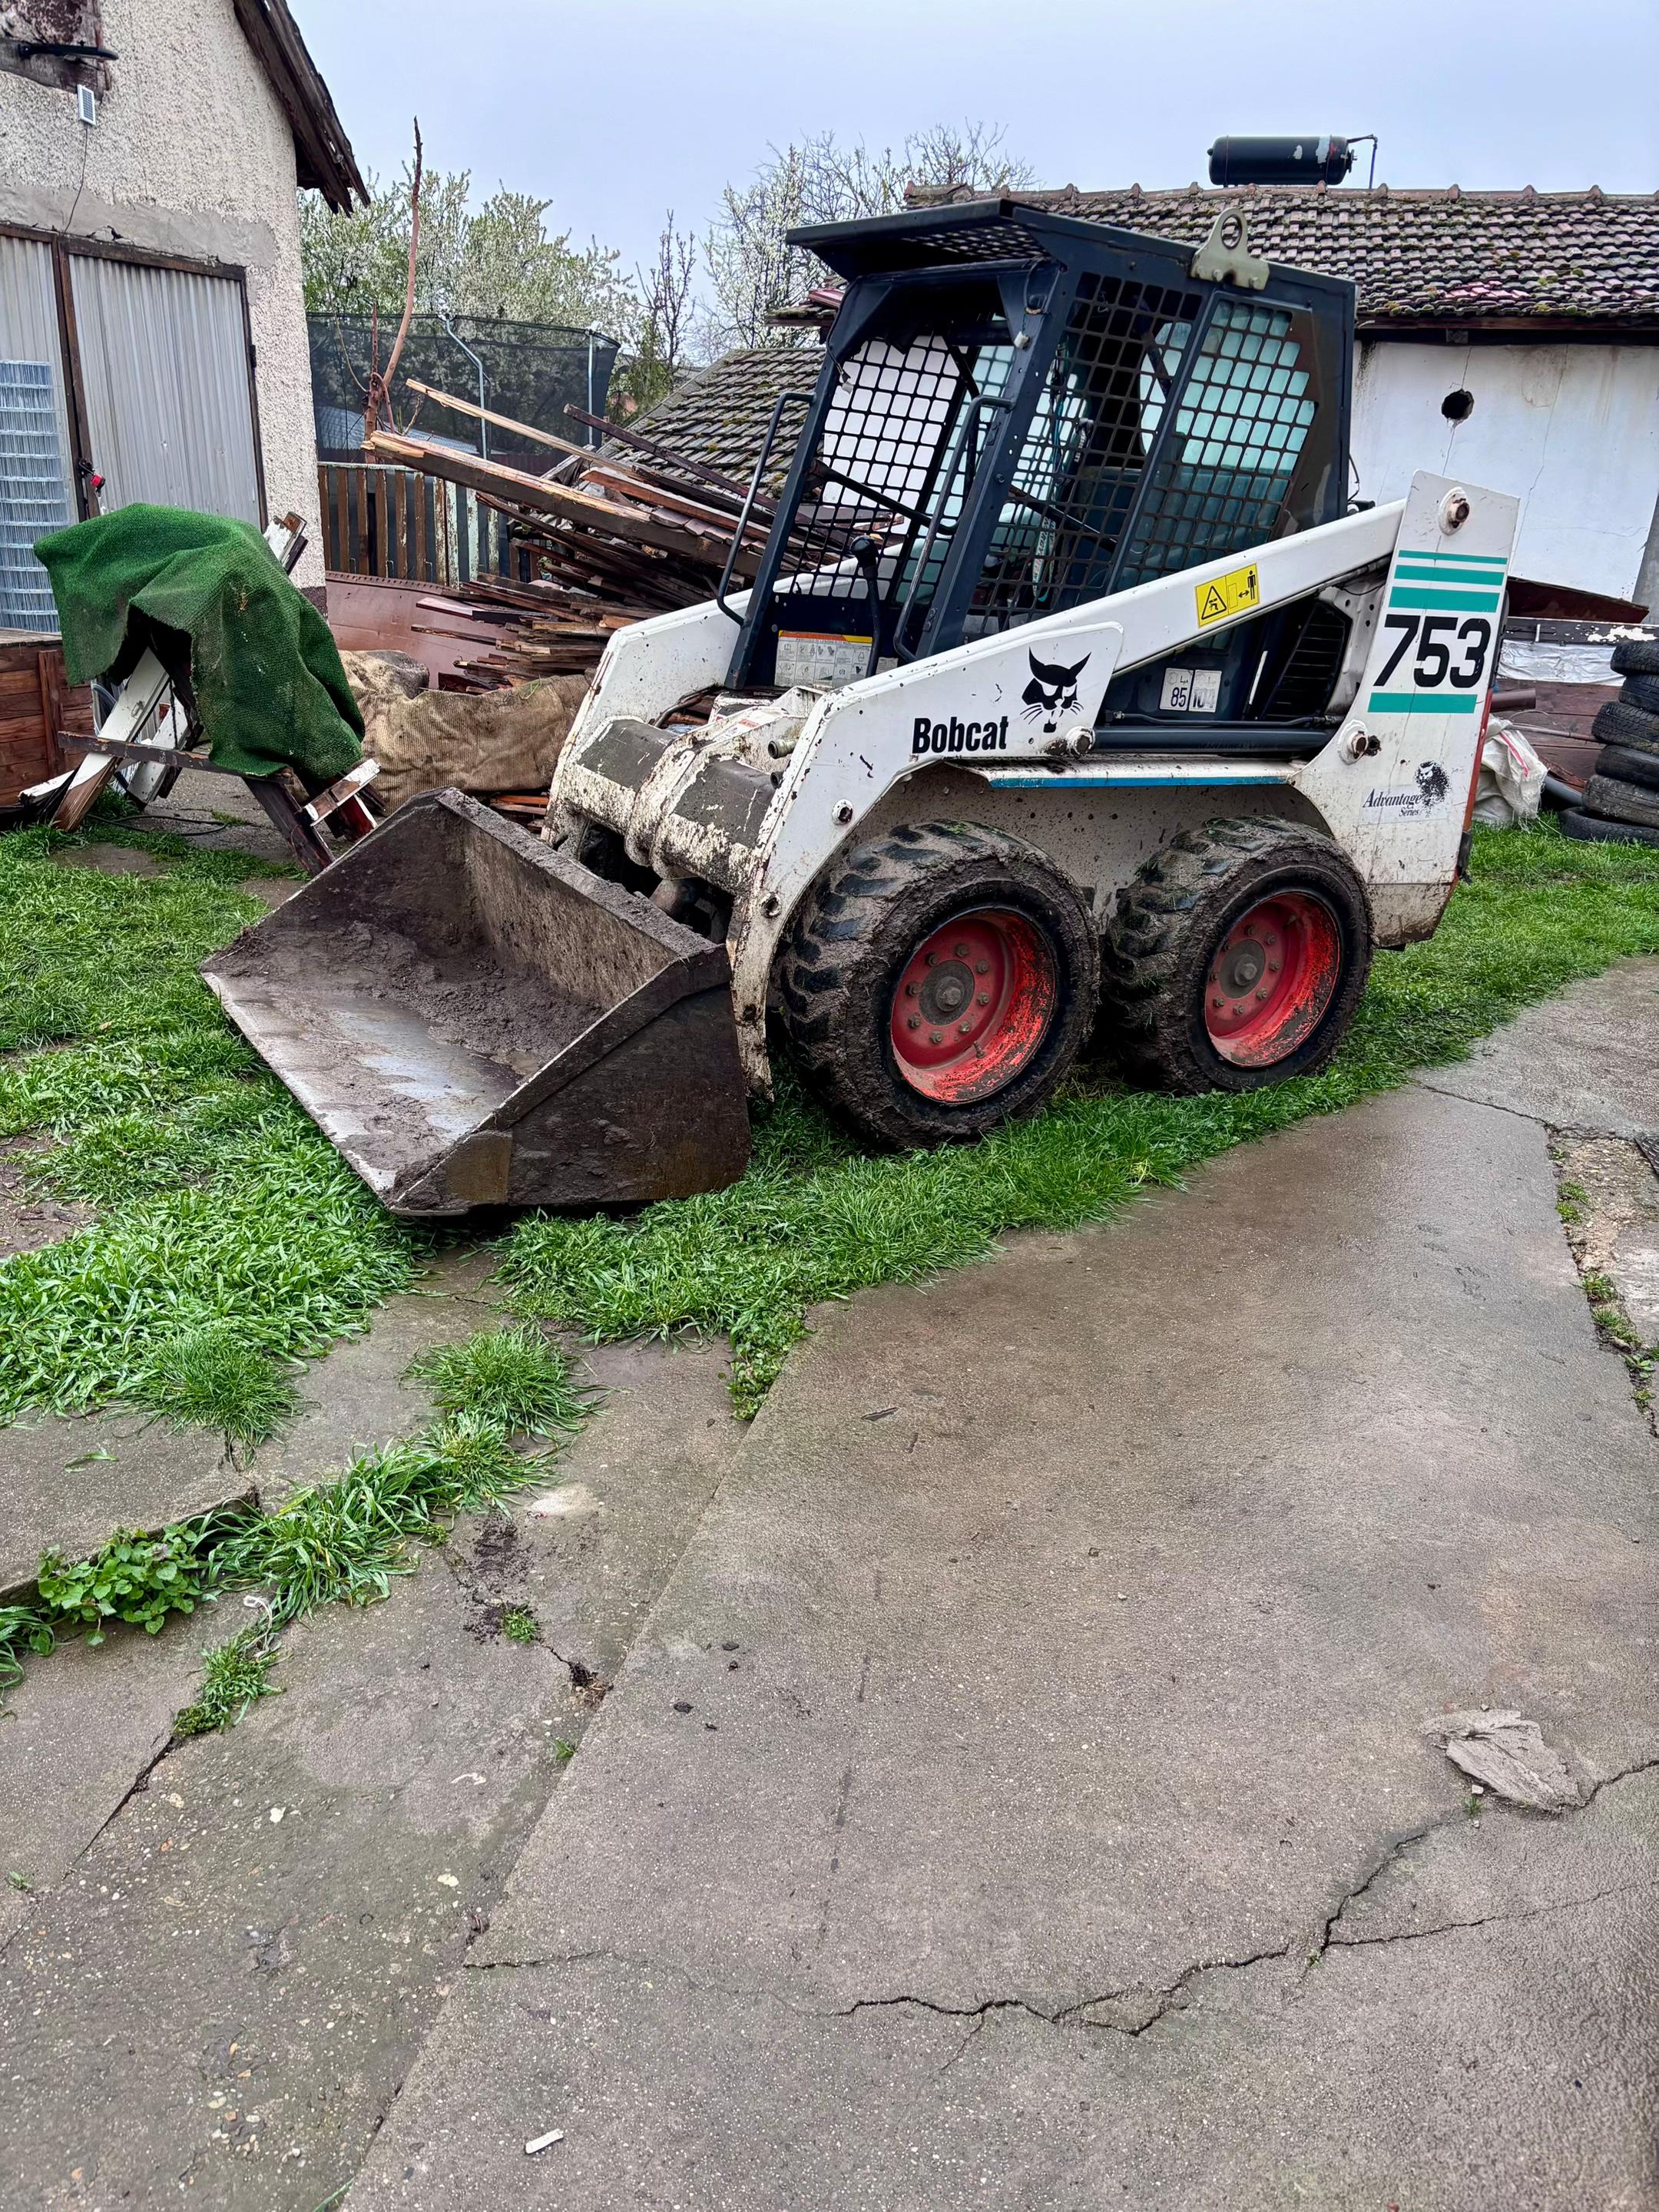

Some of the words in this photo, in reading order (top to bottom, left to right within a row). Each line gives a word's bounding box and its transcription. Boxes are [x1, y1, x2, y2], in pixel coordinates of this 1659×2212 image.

[1373, 614, 1492, 688] 753
[1171, 687, 1187, 707] 85
[912, 716, 1008, 753] Bobcat
[1363, 788, 1422, 809] Advantage
[1399, 806, 1420, 817] Series
